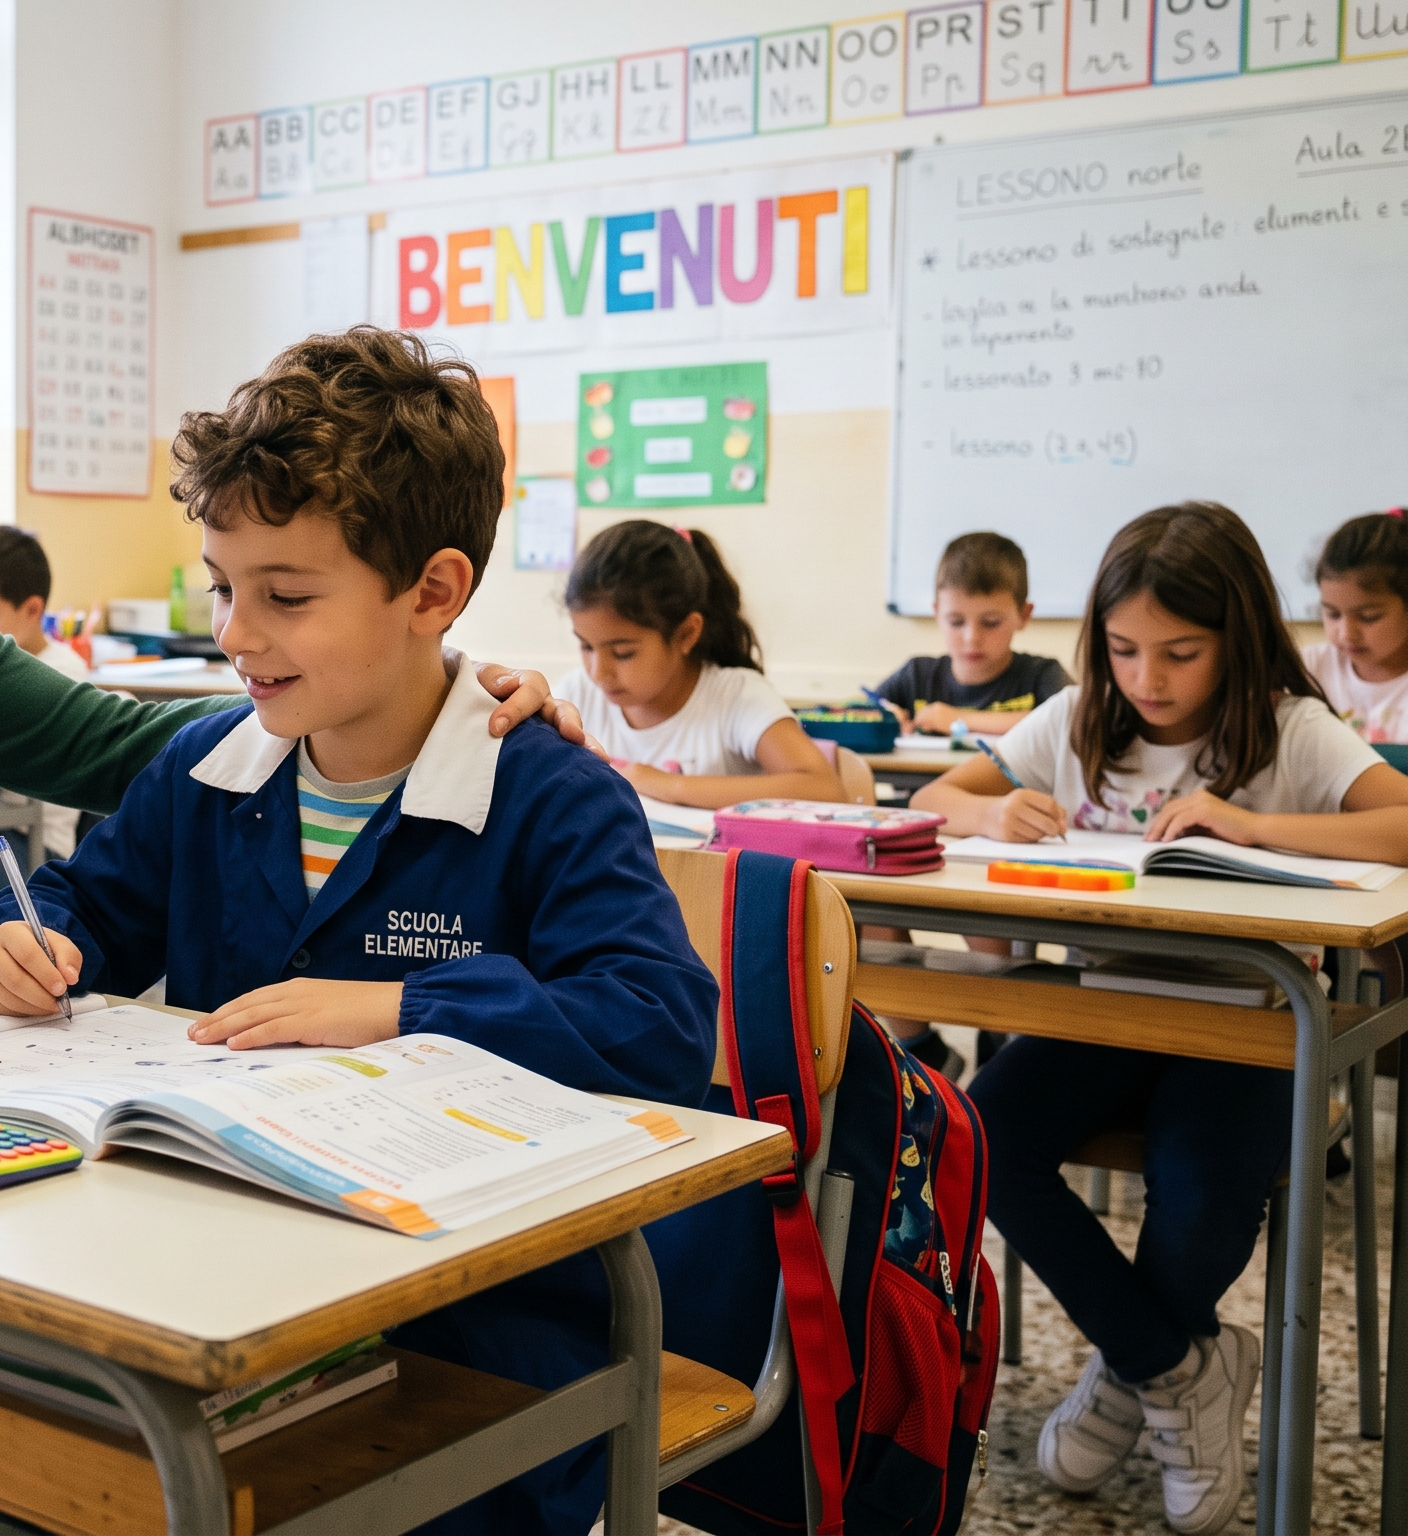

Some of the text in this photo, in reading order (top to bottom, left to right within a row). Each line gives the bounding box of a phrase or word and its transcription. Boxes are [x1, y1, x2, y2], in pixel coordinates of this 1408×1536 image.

[1173, 29, 1222, 66] Ss
[1264, 11, 1318, 52] Tt
[212, 124, 250, 152] AA
[264, 115, 304, 146] BB
[318, 105, 361, 137] CC
[559, 68, 609, 100] HH
[630, 60, 673, 94] LL
[693, 48, 751, 84] MM
[765, 37, 821, 72] NN
[837, 24, 898, 63] OO
[915, 12, 972, 51] PR
[997, 2, 1054, 39] ST
[1295, 130, 1366, 165] Aula
[955, 160, 1109, 208] LESSONO
[397, 185, 869, 330] BENVENUTI
[387, 910, 463, 935] SCUOLA
[364, 934, 483, 960] ELEMENTARE
